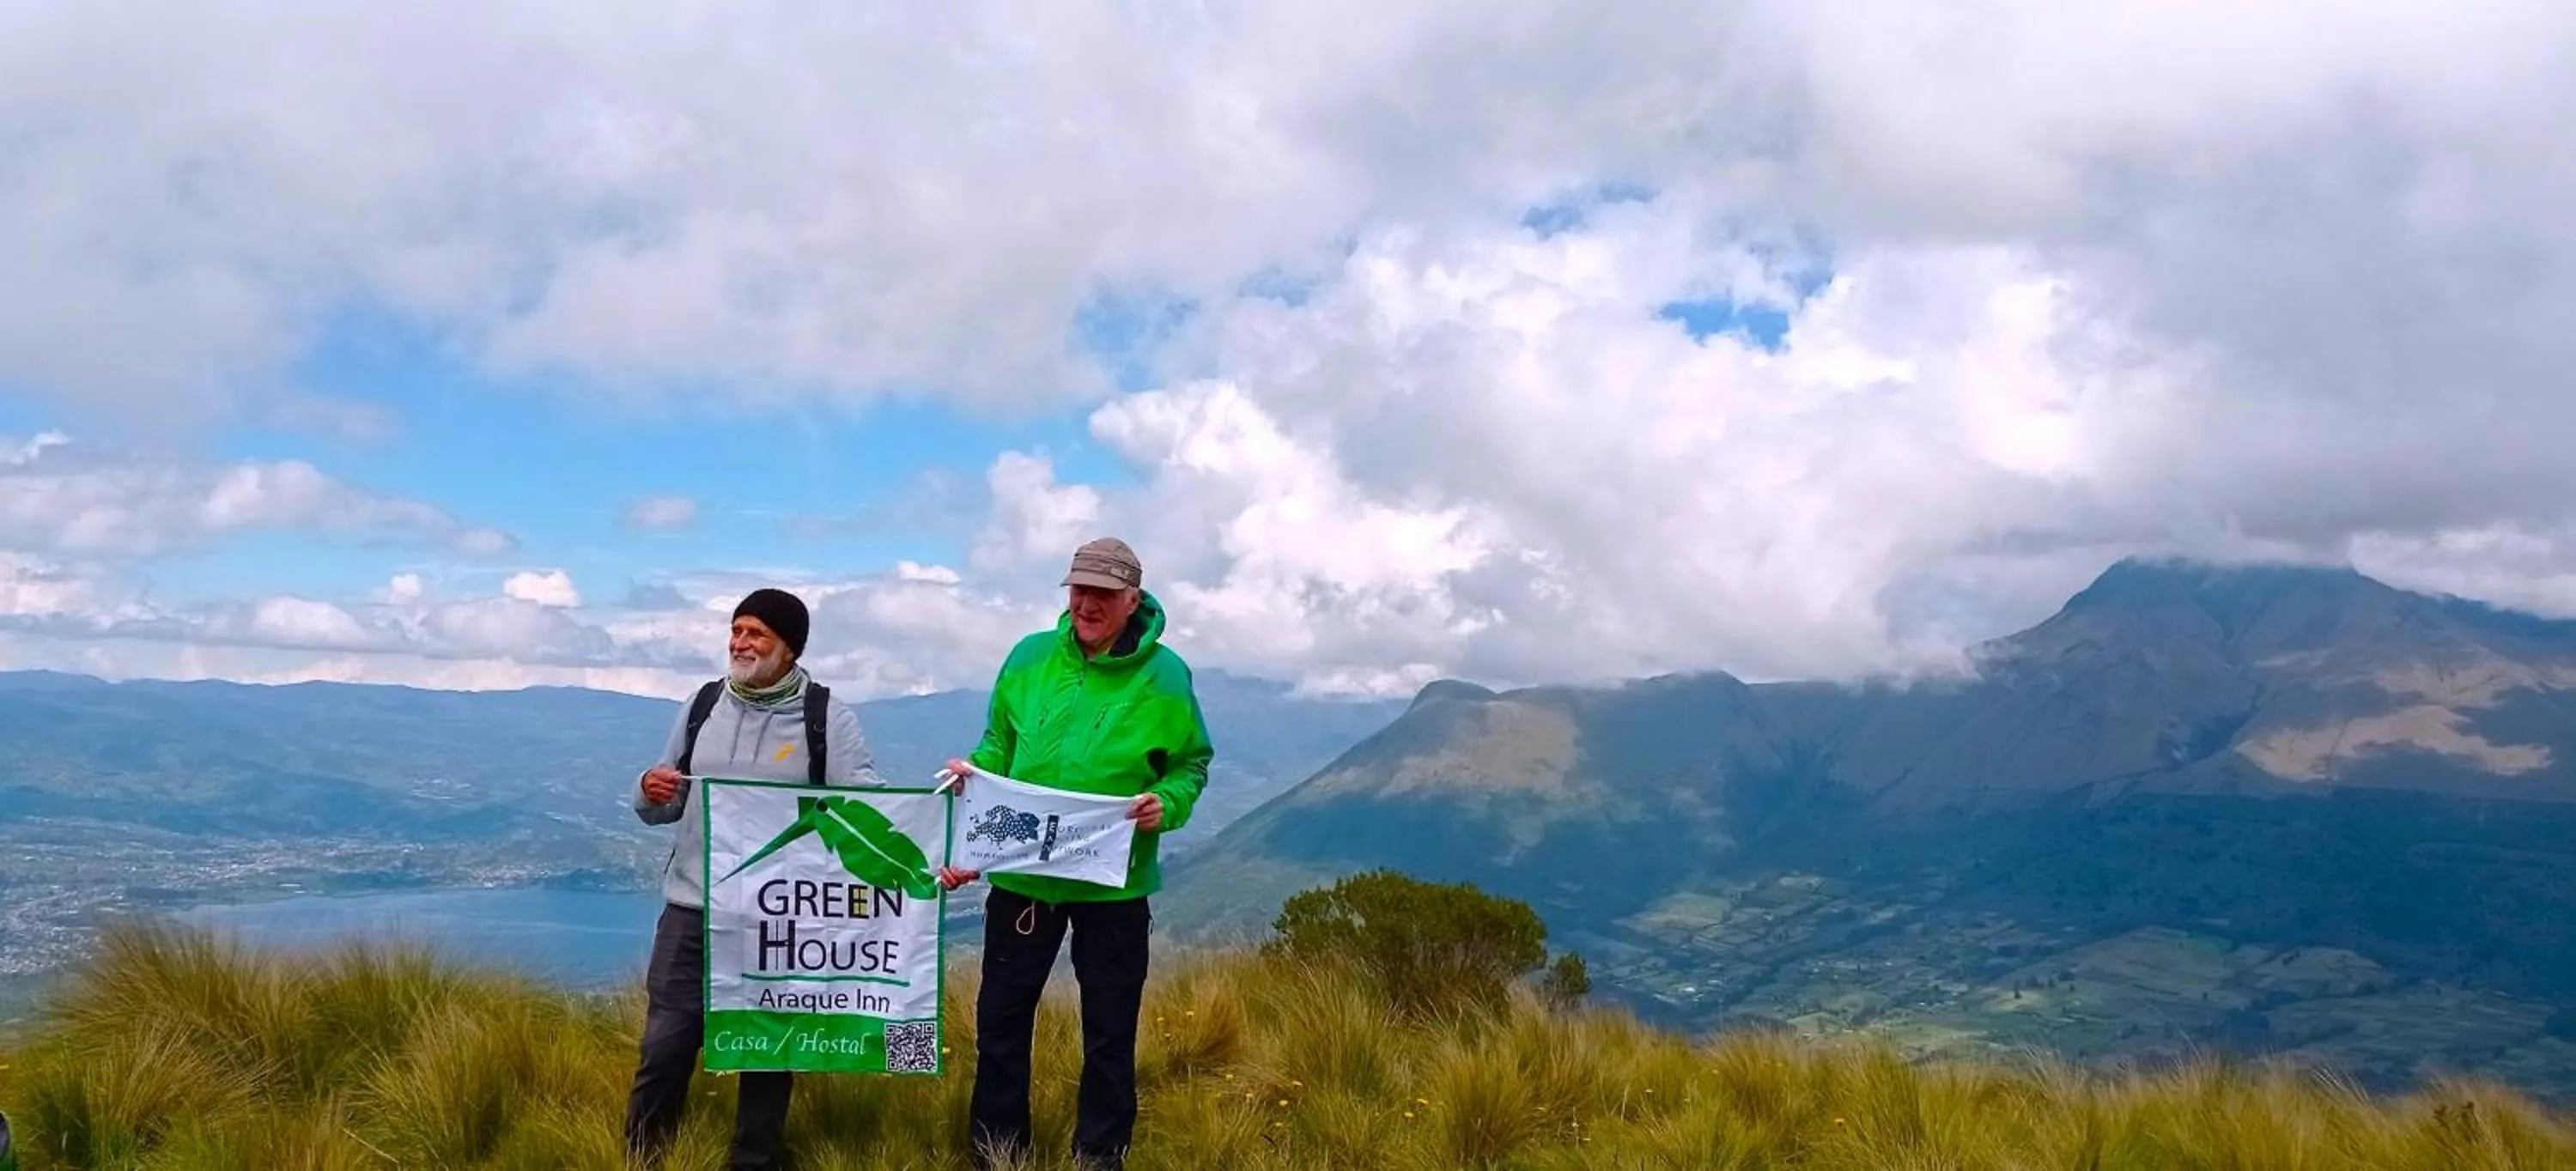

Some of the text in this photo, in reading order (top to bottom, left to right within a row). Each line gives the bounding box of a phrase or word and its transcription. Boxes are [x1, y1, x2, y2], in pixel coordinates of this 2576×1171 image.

[757, 878, 902, 919] GREEN
[757, 919, 900, 974] HOUSE
[758, 988, 890, 1013] Araque Inn
[714, 1031, 769, 1053] Casa
[796, 1028, 866, 1055] Hostal
